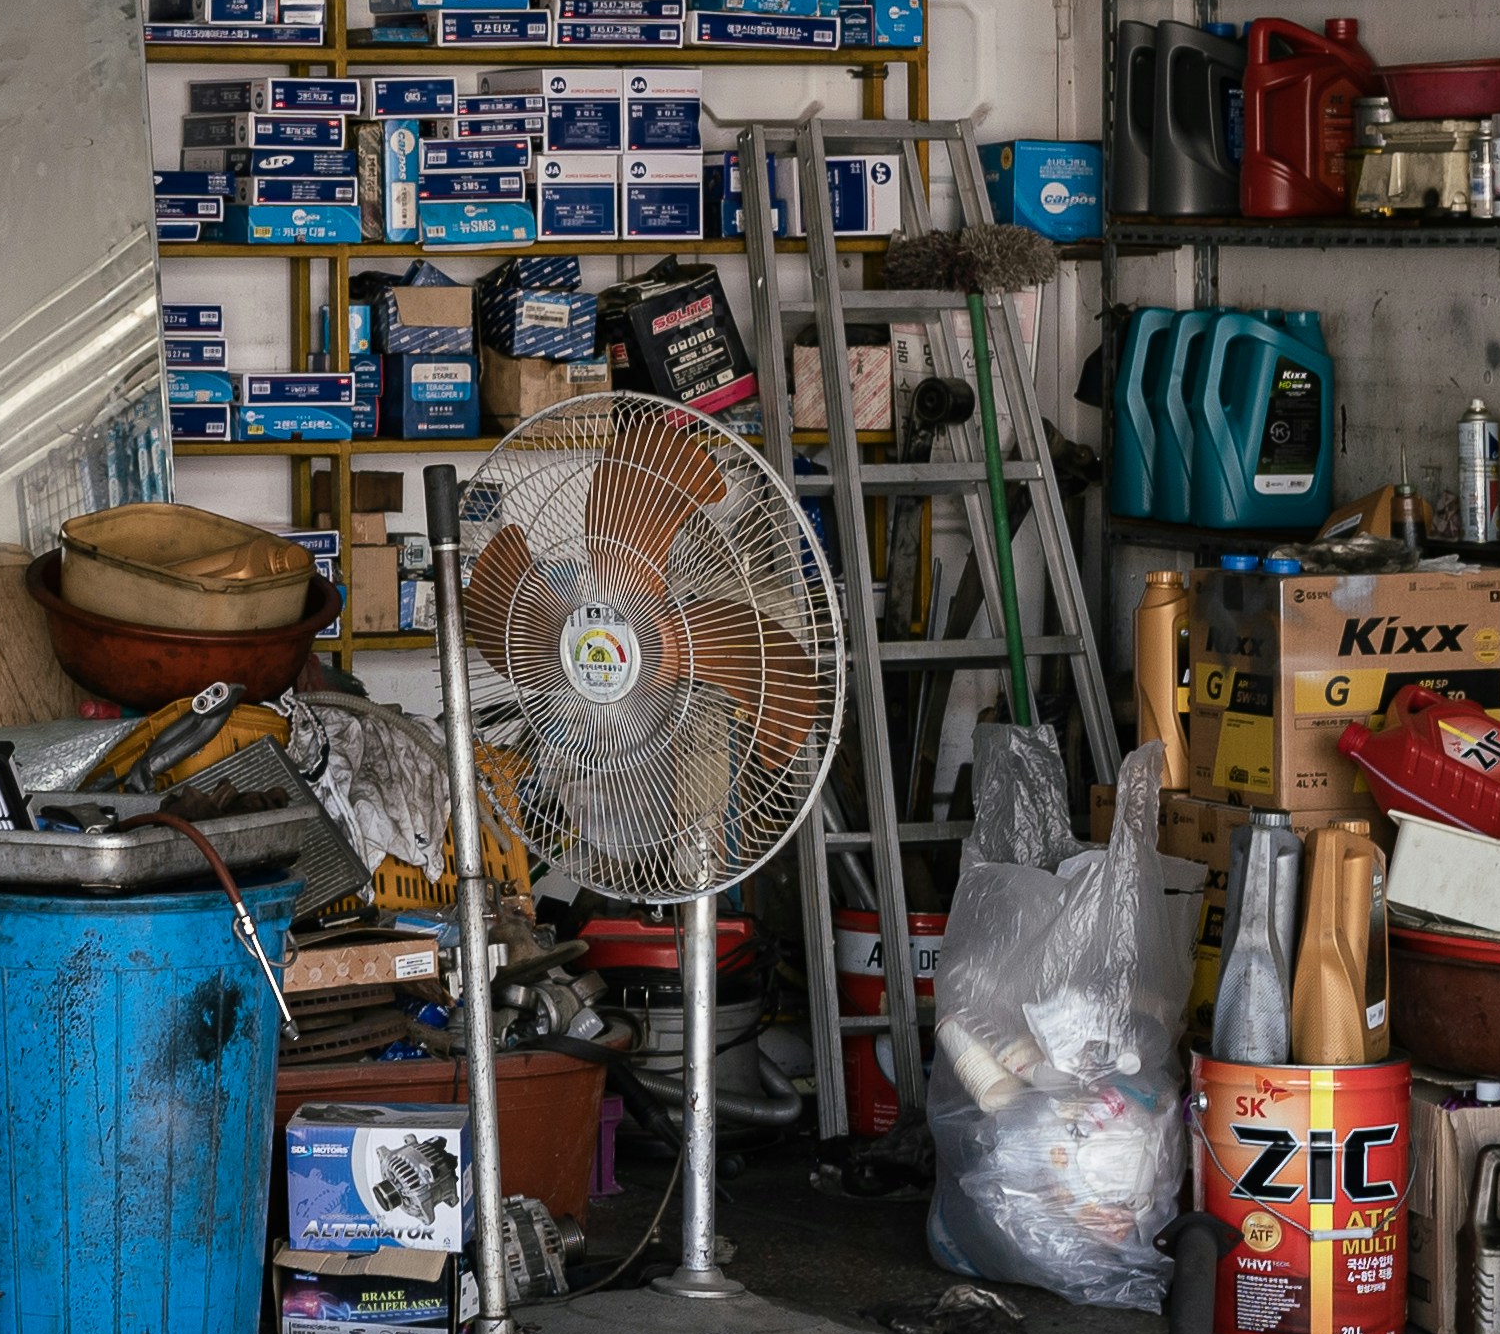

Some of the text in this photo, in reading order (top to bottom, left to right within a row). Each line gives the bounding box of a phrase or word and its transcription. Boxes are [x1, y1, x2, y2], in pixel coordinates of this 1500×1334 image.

[551, 80, 566, 91] JA
[632, 80, 646, 91] JA
[546, 166, 561, 176] JA
[631, 165, 646, 175] JA
[1043, 193, 1097, 207] carpos
[652, 294, 713, 335] SOLITE
[1282, 370, 1308, 381] Kixx
[1337, 616, 1470, 657] Kixx
[1206, 670, 1224, 700] G
[1325, 668, 1351, 707] G
[1320, 778, 1328, 788] 4
[1235, 1095, 1268, 1119] SK
[290, 1145, 349, 1156] SDL MOTORS
[1228, 1122, 1400, 1204] ZIC
[1345, 1208, 1398, 1233] ATF
[301, 1219, 436, 1243] ALTERNATOR
[1248, 1230, 1273, 1243] ATF
[1342, 1234, 1398, 1256] MULTI
[1346, 1255, 1394, 1271] 국산/수입차
[361, 1290, 405, 1304] BRAKE
[356, 1300, 402, 1314] CALIPER
